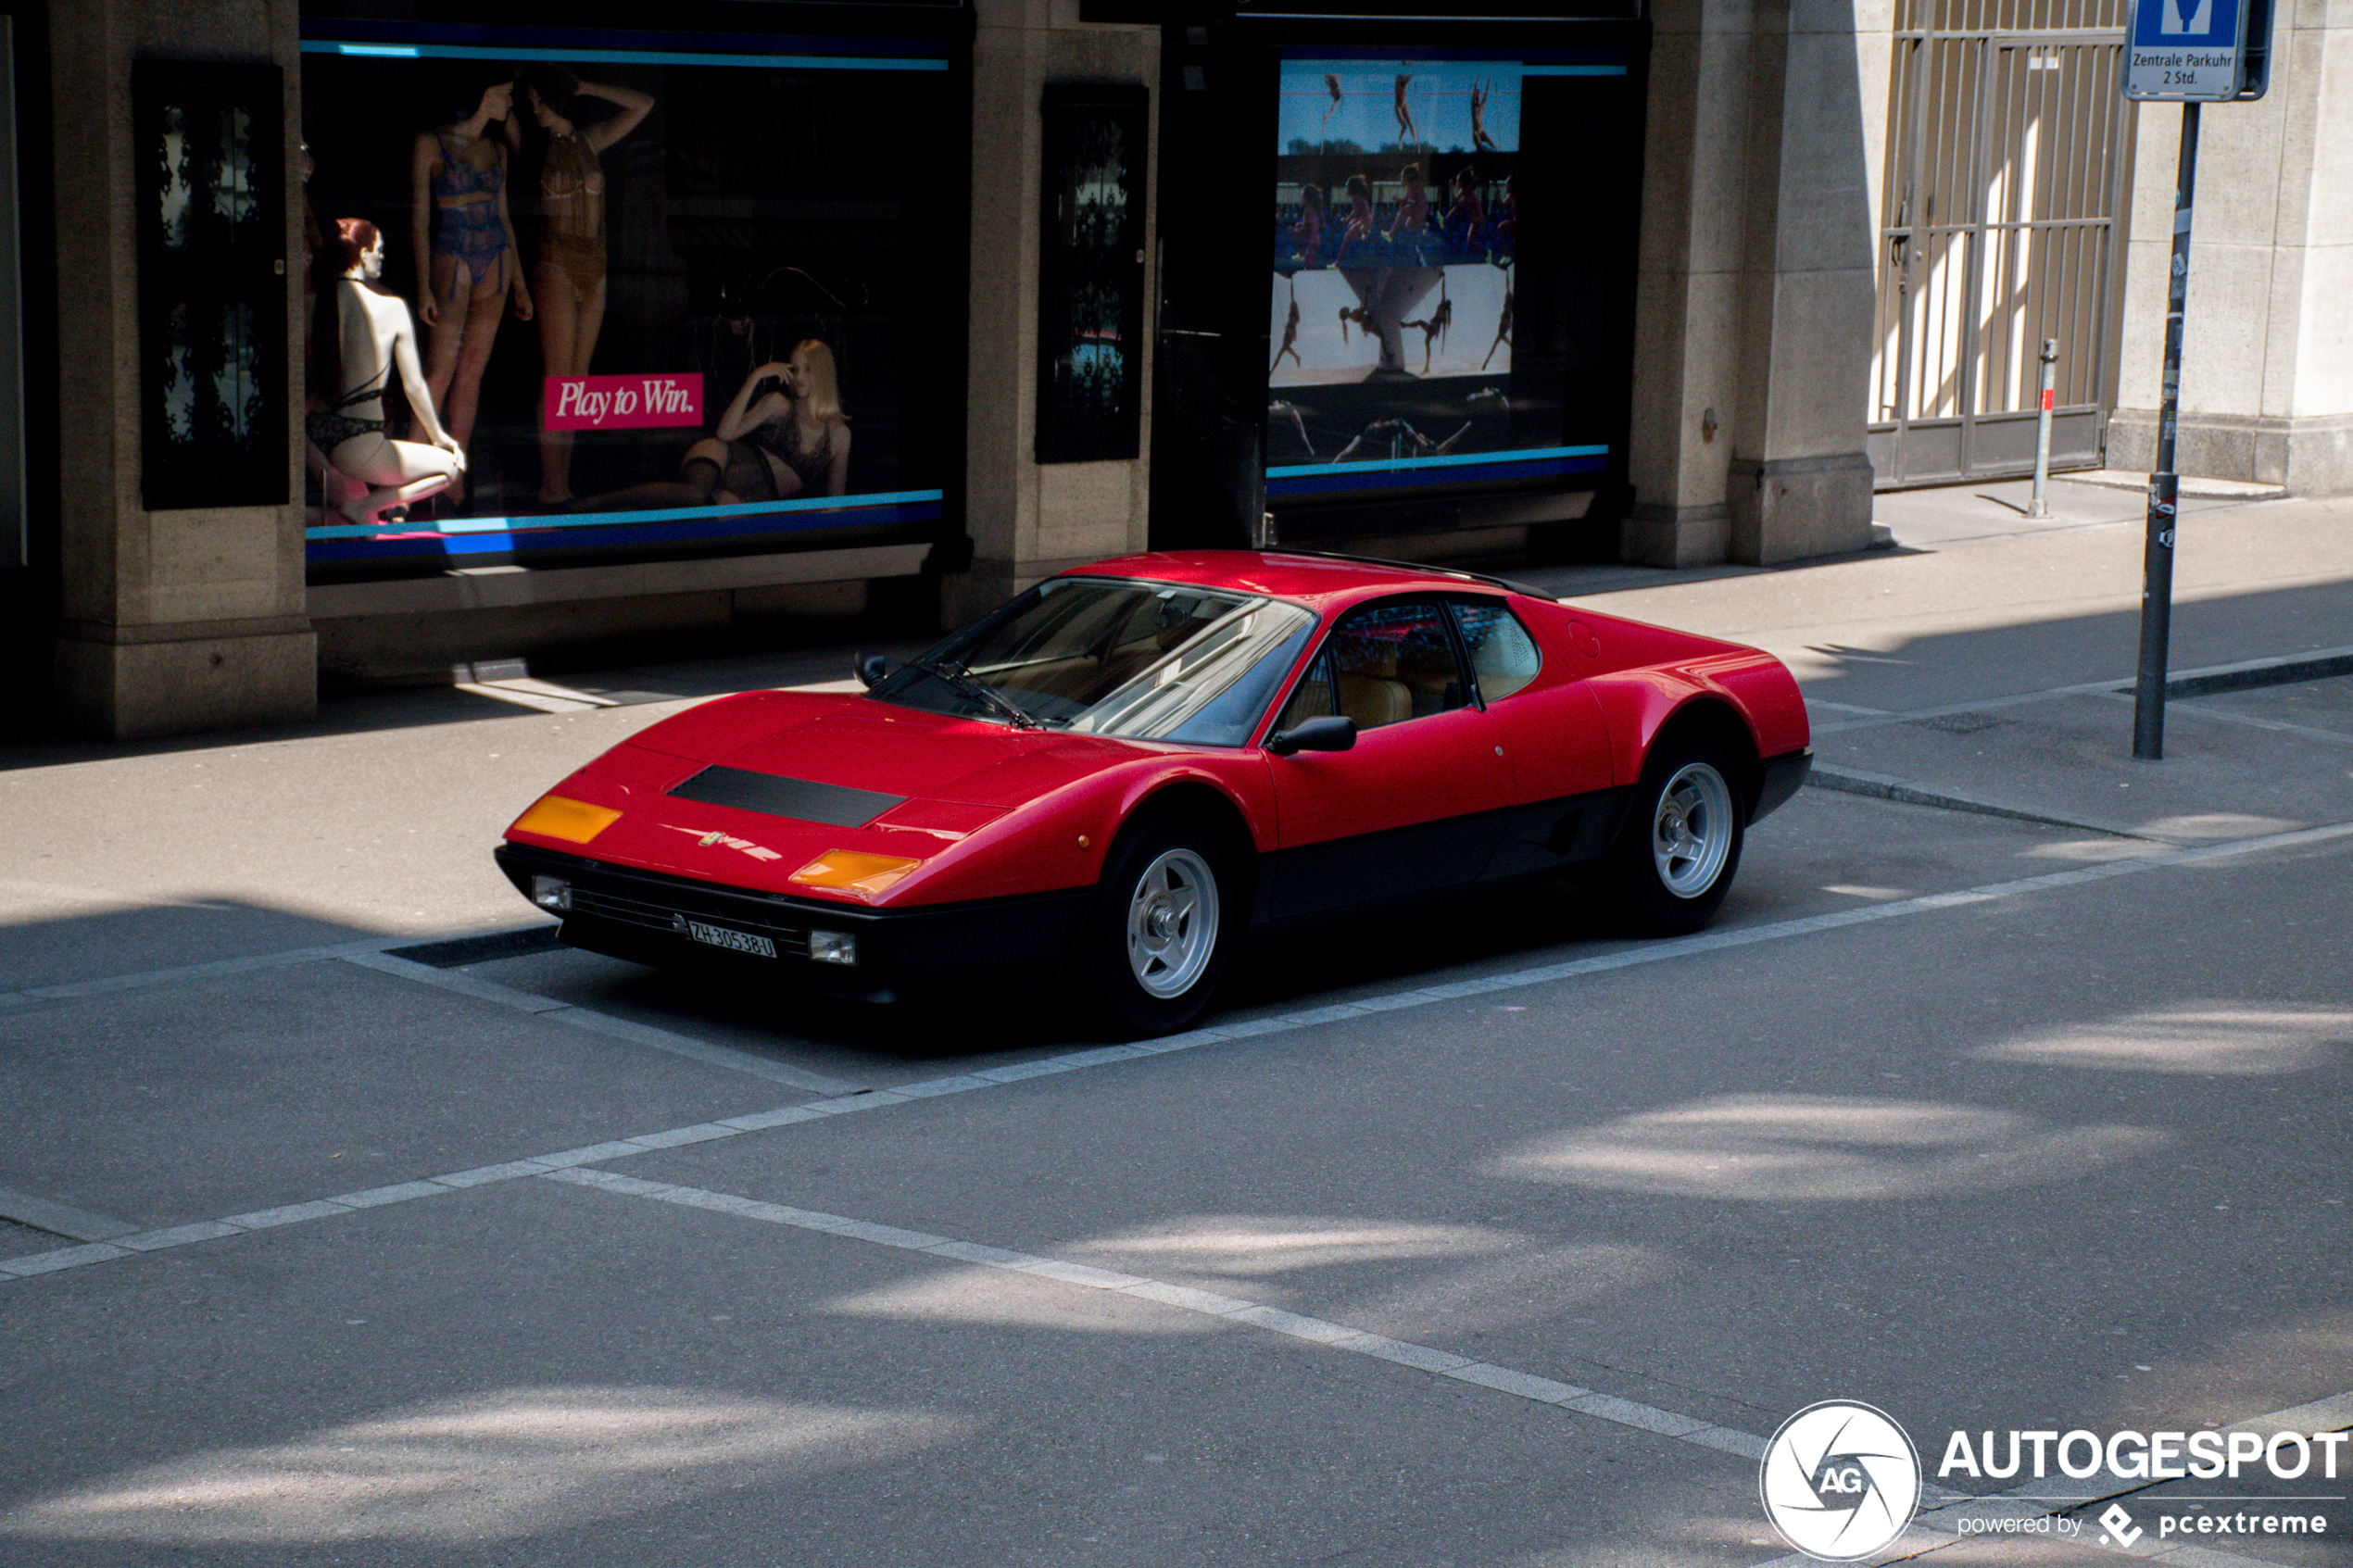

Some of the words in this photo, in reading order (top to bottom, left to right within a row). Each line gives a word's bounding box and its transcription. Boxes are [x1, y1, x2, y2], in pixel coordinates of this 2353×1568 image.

[2133, 53, 2183, 67] Zentrale
[2185, 53, 2233, 67] Parkuhr
[2163, 71, 2170, 84] 2
[2174, 70, 2197, 84] Std.
[556, 381, 611, 425] Play
[613, 386, 637, 416] to
[642, 379, 694, 414] Win.
